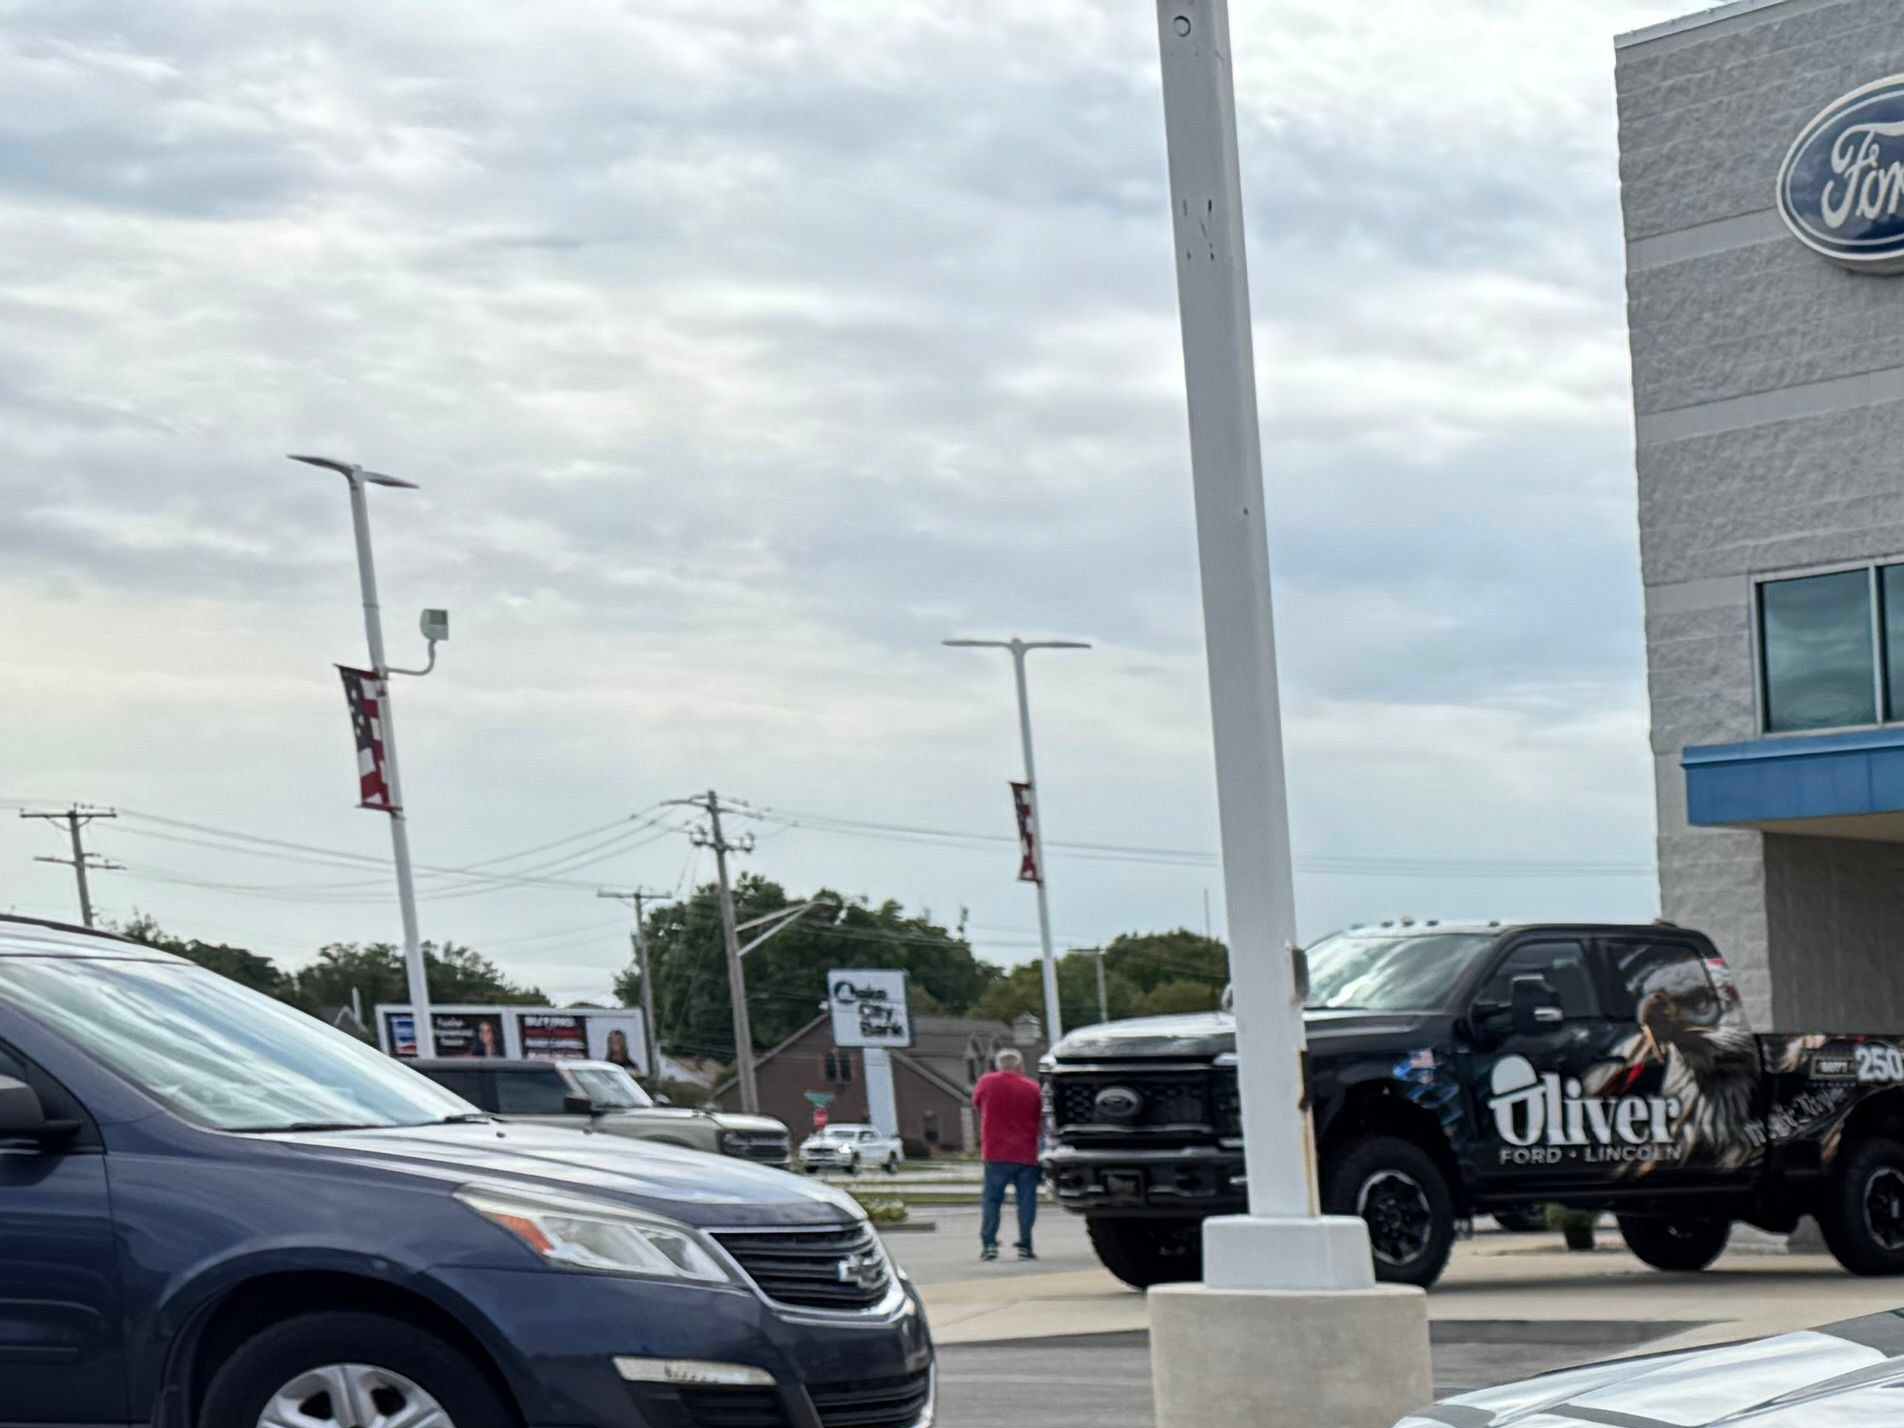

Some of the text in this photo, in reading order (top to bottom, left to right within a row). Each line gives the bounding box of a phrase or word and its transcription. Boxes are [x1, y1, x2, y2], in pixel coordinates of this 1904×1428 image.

[1488, 1054, 1682, 1146] Oliver
[1500, 1145, 1682, 1165] FORD LINCOLN
